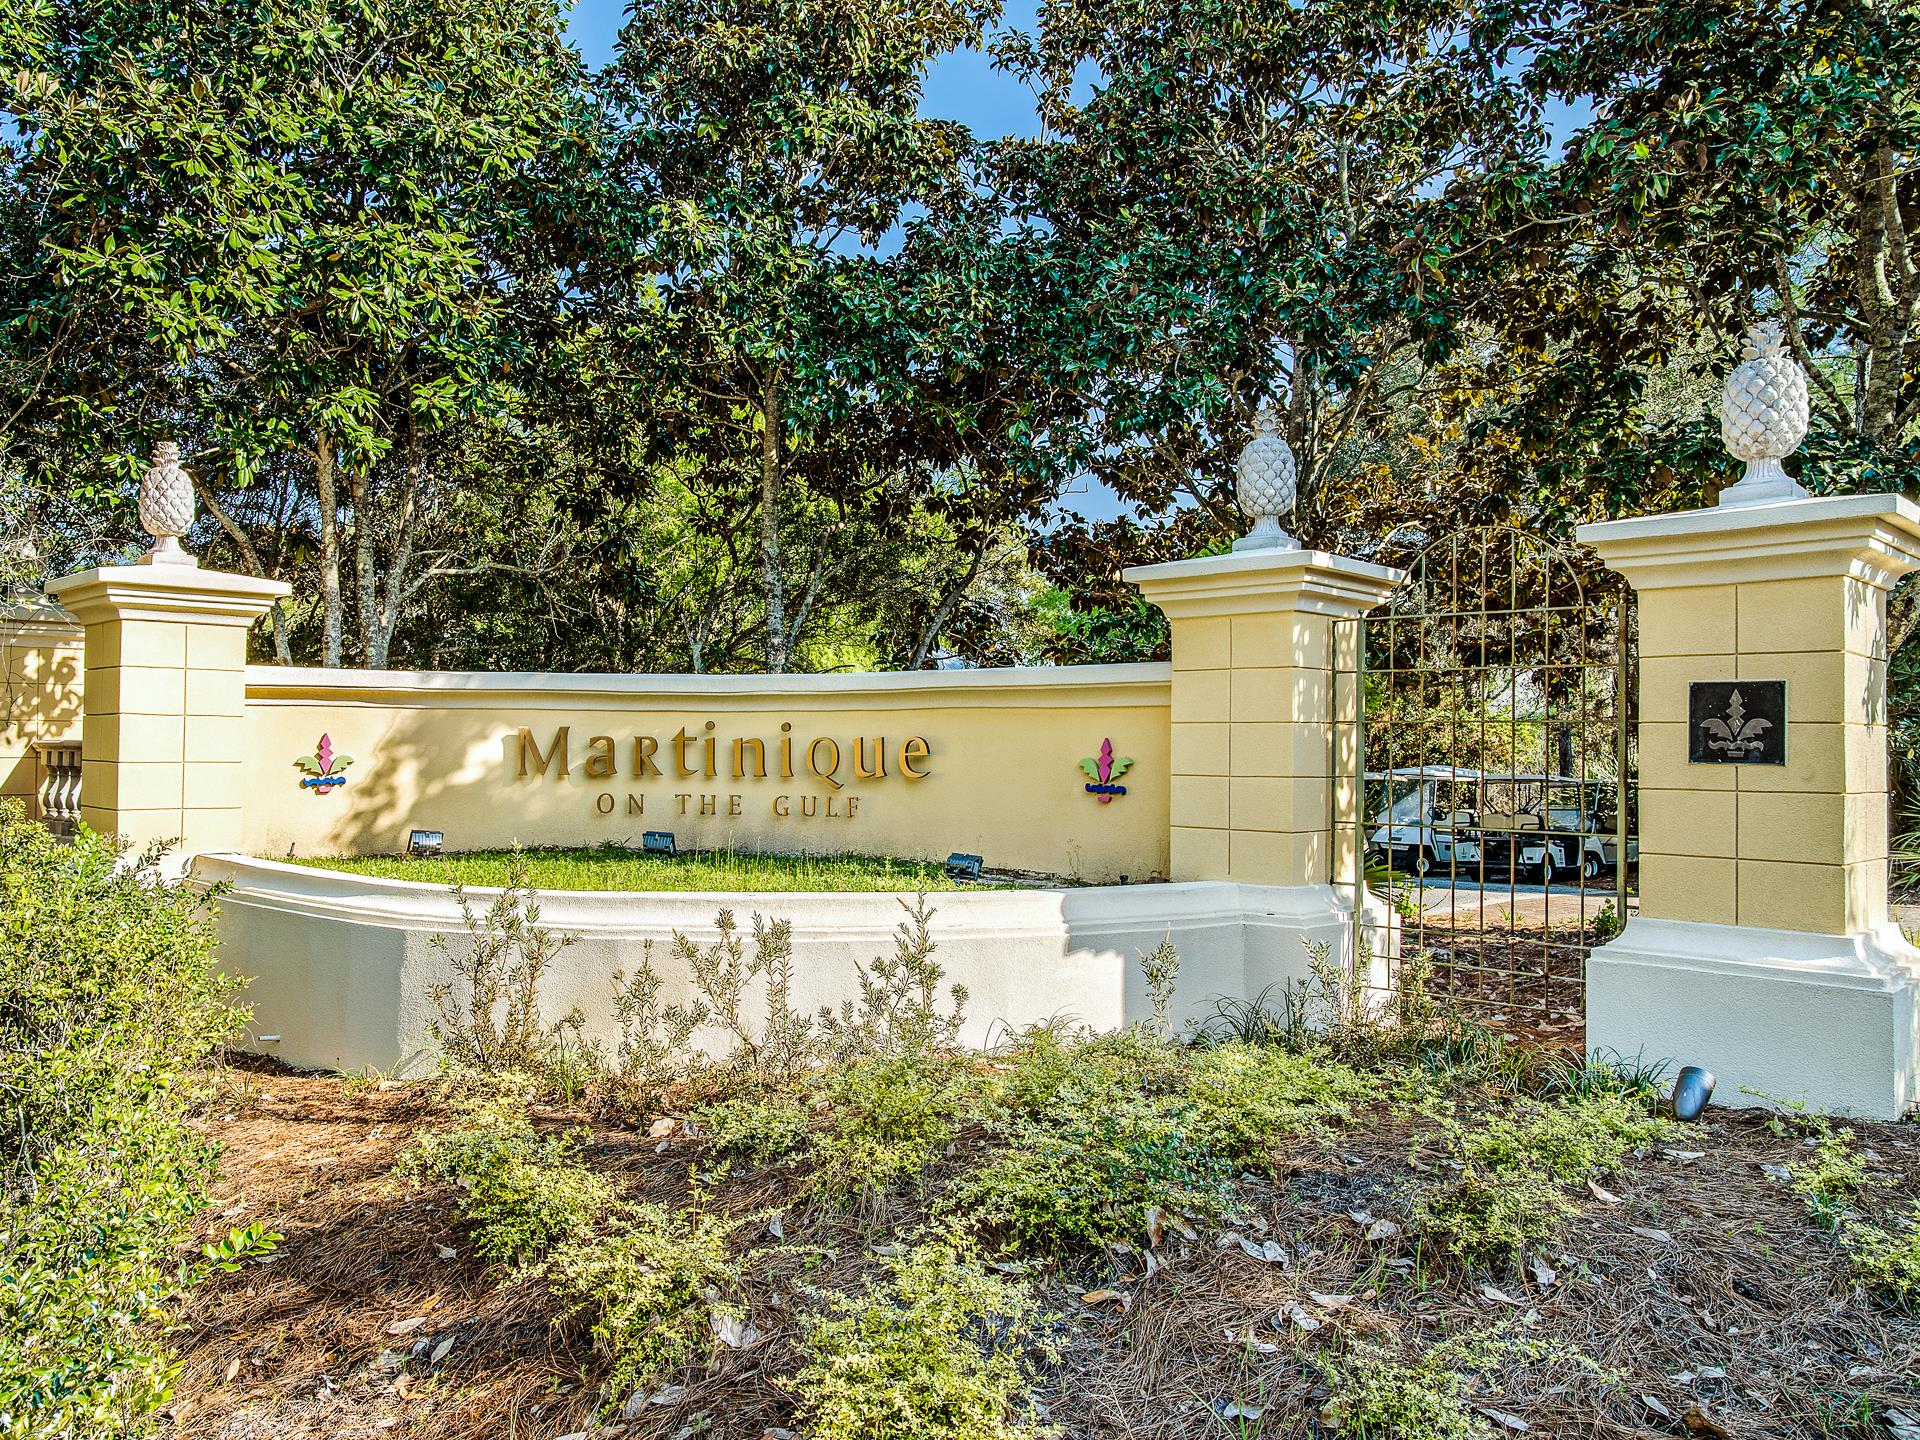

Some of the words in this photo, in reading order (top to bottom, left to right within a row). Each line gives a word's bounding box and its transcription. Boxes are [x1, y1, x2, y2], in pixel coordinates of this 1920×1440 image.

[596, 793, 645, 815] ON
[675, 793, 742, 815] THE
[772, 795, 861, 817] GULF
